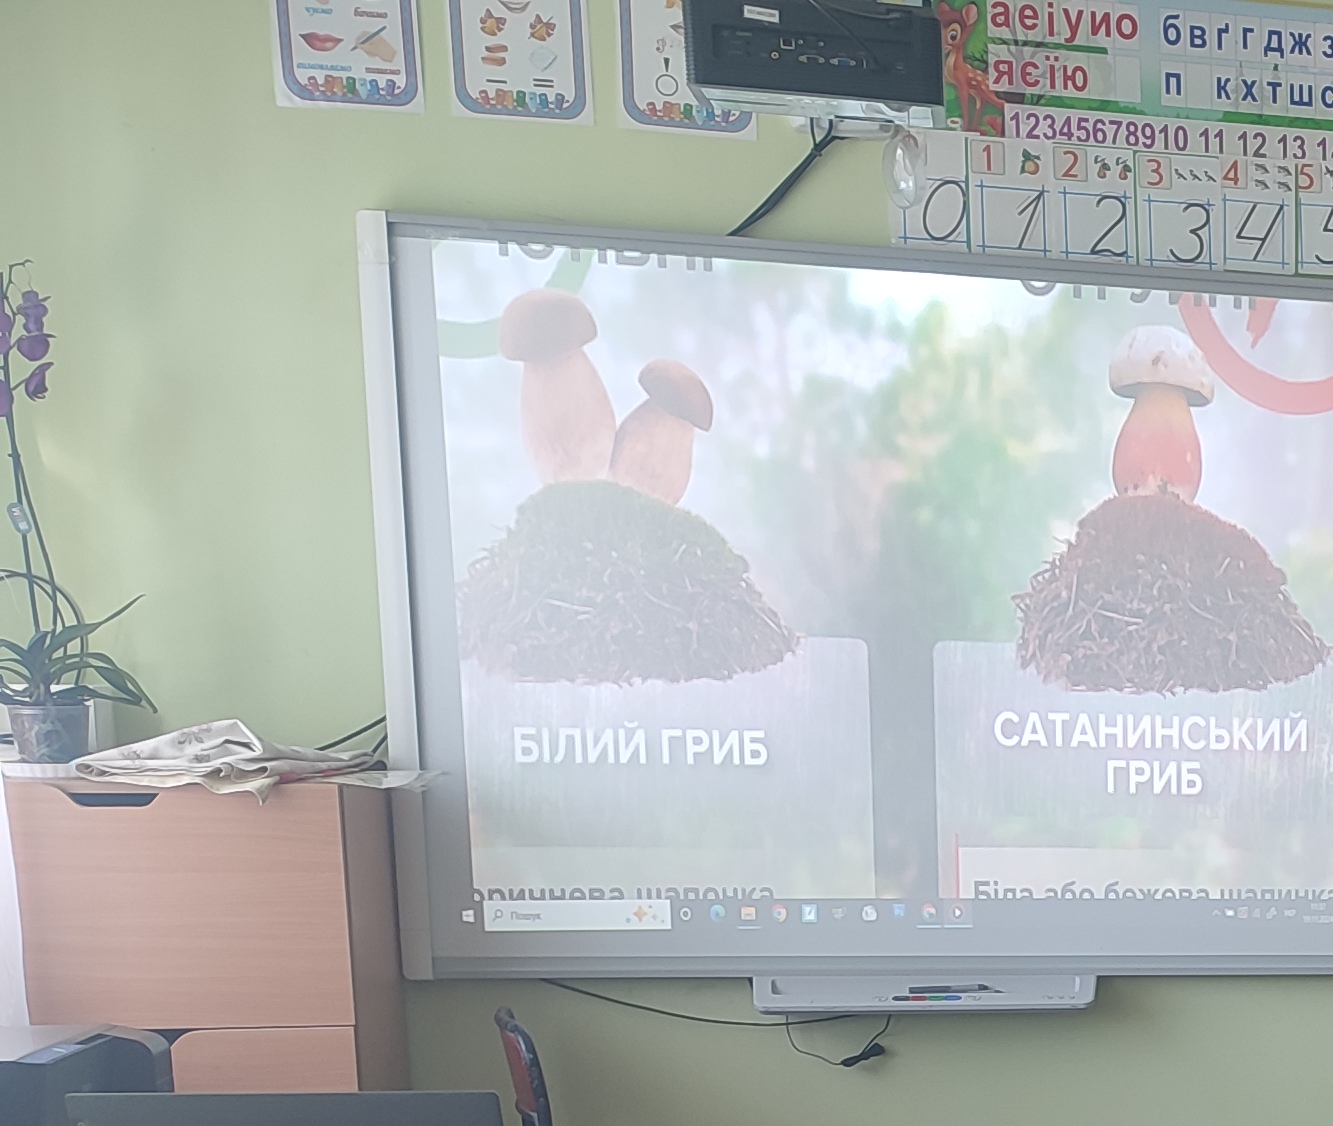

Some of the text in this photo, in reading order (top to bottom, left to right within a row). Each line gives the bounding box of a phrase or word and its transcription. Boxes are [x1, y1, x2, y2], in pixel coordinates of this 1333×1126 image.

[1158, 123, 1189, 152] 10
[1198, 127, 1225, 155] 11
[1237, 130, 1268, 159] 12
[1277, 132, 1306, 160] 13
[982, 144, 992, 172] 1
[1063, 150, 1079, 178] 2
[1147, 158, 1164, 186] 3
[1222, 160, 1239, 186] 4
[1299, 164, 1315, 190] 5
[921, 177, 965, 242] 0
[1018, 190, 1043, 249] 1
[1090, 195, 1128, 256] 2
[1169, 202, 1210, 262] 3
[1236, 203, 1285, 260] 4
[513, 721, 768, 766] БІЛИЙ ГРИБ
[994, 710, 1308, 752] САТАНИНСЬКИЙ
[1106, 760, 1203, 795] ГРИБ
